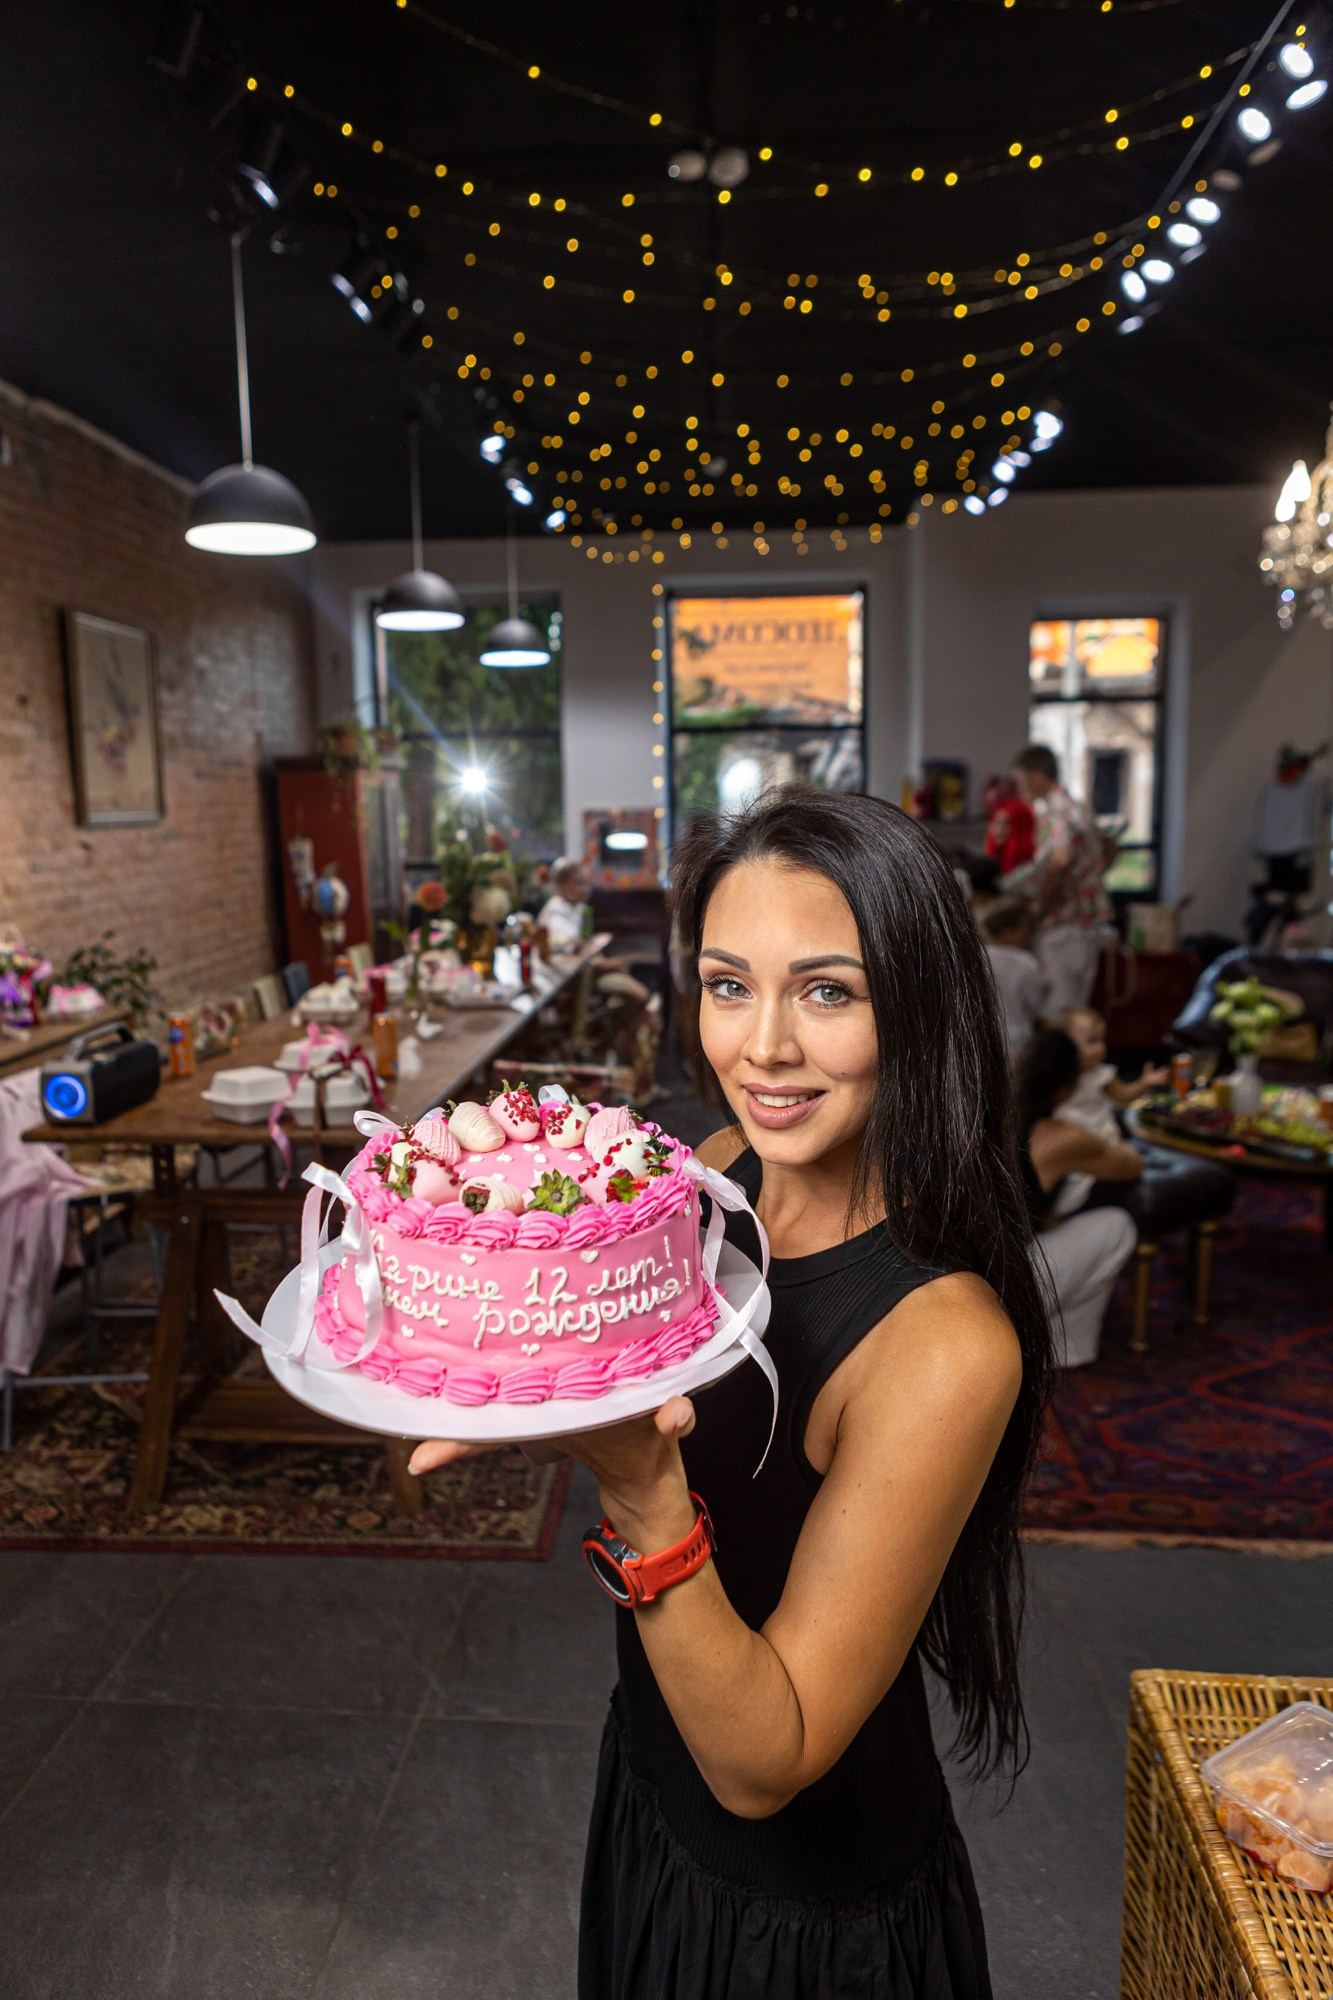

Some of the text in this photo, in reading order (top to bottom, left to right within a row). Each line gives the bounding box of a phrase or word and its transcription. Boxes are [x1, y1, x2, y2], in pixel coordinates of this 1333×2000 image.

[472, 1258, 691, 1349] рождения!
[522, 1266, 578, 1307] 12
[587, 1235, 673, 1297] лет!
